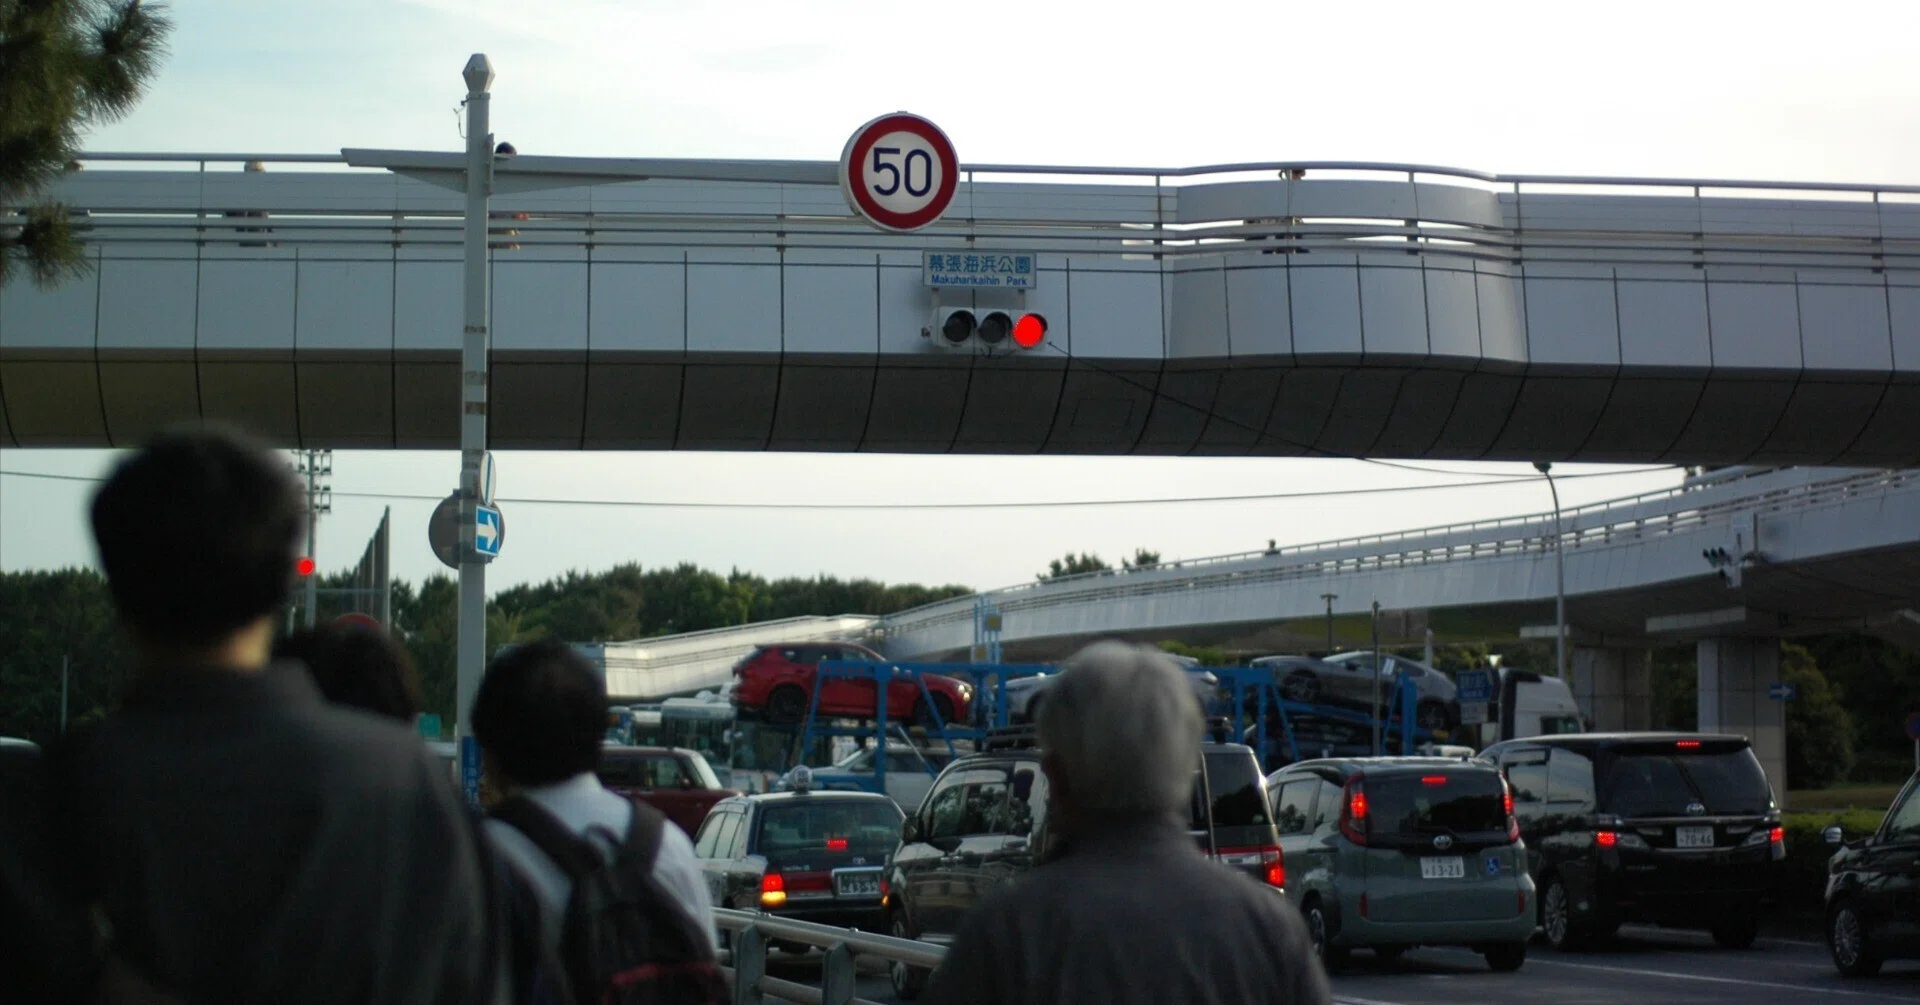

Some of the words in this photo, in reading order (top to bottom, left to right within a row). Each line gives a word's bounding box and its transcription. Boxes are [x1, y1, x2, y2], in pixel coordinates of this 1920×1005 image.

[873, 147, 932, 197] 50
[929, 254, 1030, 274] 幕張海浜公園
[931, 274, 1000, 285] Makuharikaihin
[1006, 276, 1028, 285] Park
